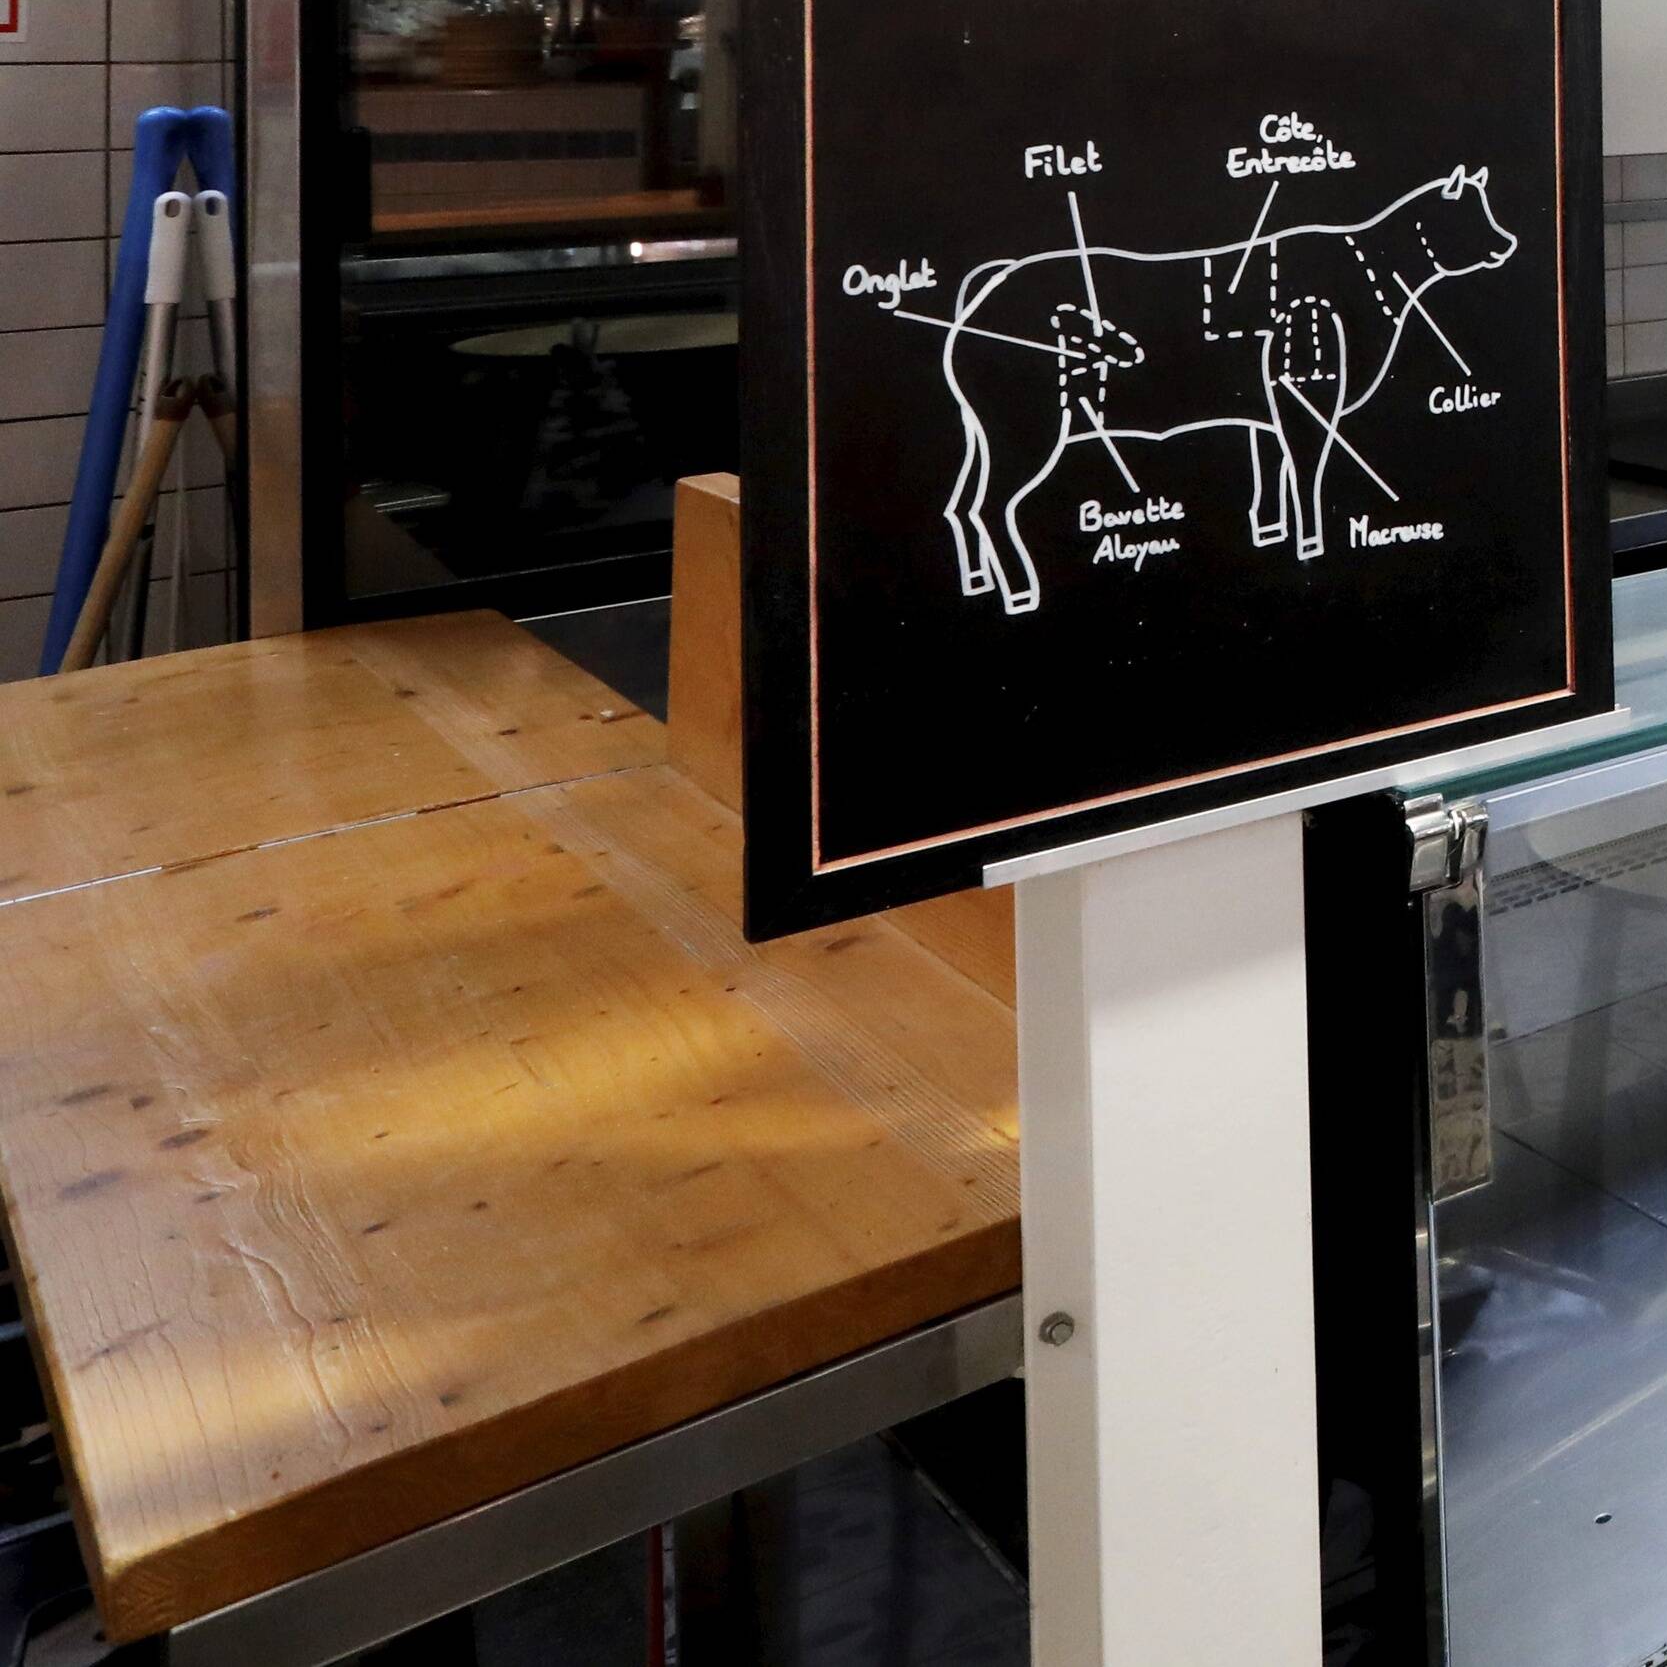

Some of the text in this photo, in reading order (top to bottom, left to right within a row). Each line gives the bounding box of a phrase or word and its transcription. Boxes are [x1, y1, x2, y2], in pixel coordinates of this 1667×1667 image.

[1024, 140, 1103, 180] Filet
[1225, 138, 1357, 180] Entrecôte
[841, 257, 938, 310] Onglet
[1428, 385, 1502, 414] Collier
[1079, 495, 1185, 532] Bavette
[1349, 515, 1444, 548] Macreuse
[1092, 533, 1180, 572] Aloyau
